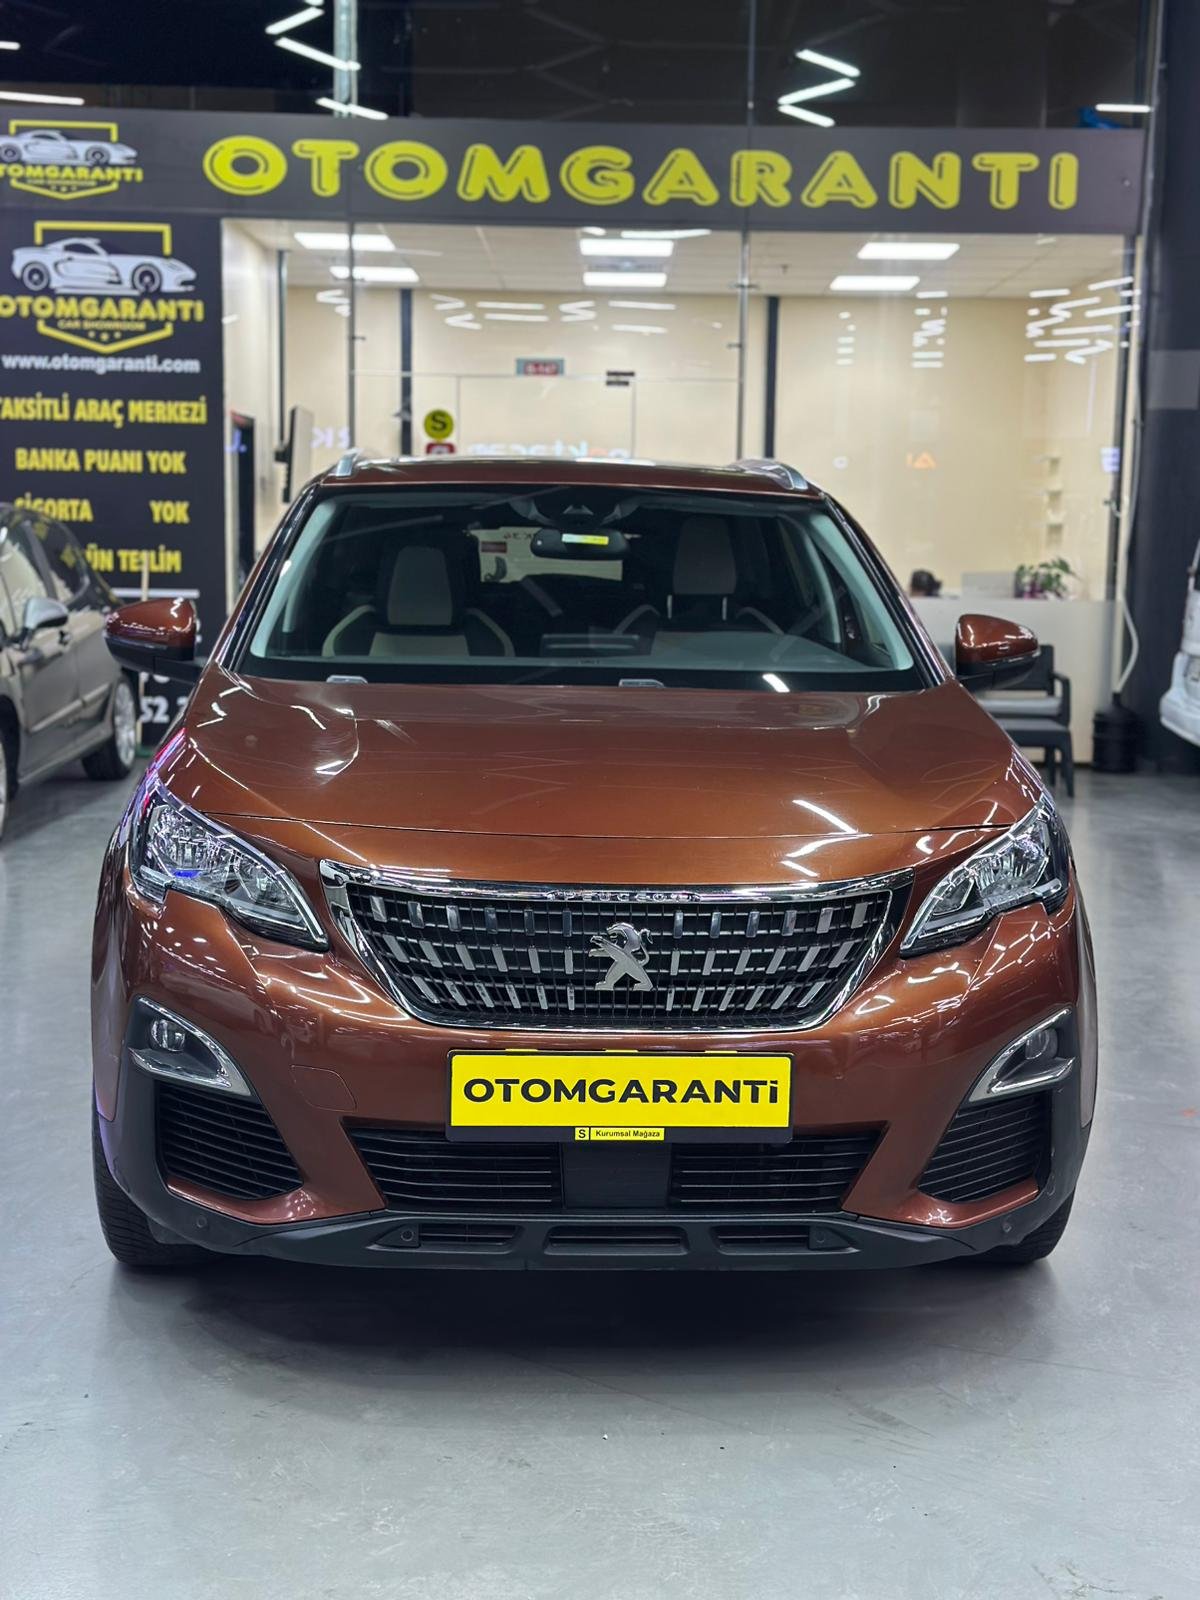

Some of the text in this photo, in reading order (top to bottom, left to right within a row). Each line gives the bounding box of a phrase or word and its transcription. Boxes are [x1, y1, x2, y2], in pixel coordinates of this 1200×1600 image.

[202, 135, 1080, 210] OTOMGARANTI
[1, 352, 201, 375] www.otomgaranti.com
[0, 392, 207, 429] AKSİTLİ ARAÇ MERKEZİ
[15, 448, 188, 475] BANKA PUANI YOK
[149, 500, 190, 524] YOK
[633, 1130, 660, 1138] Mağaza
